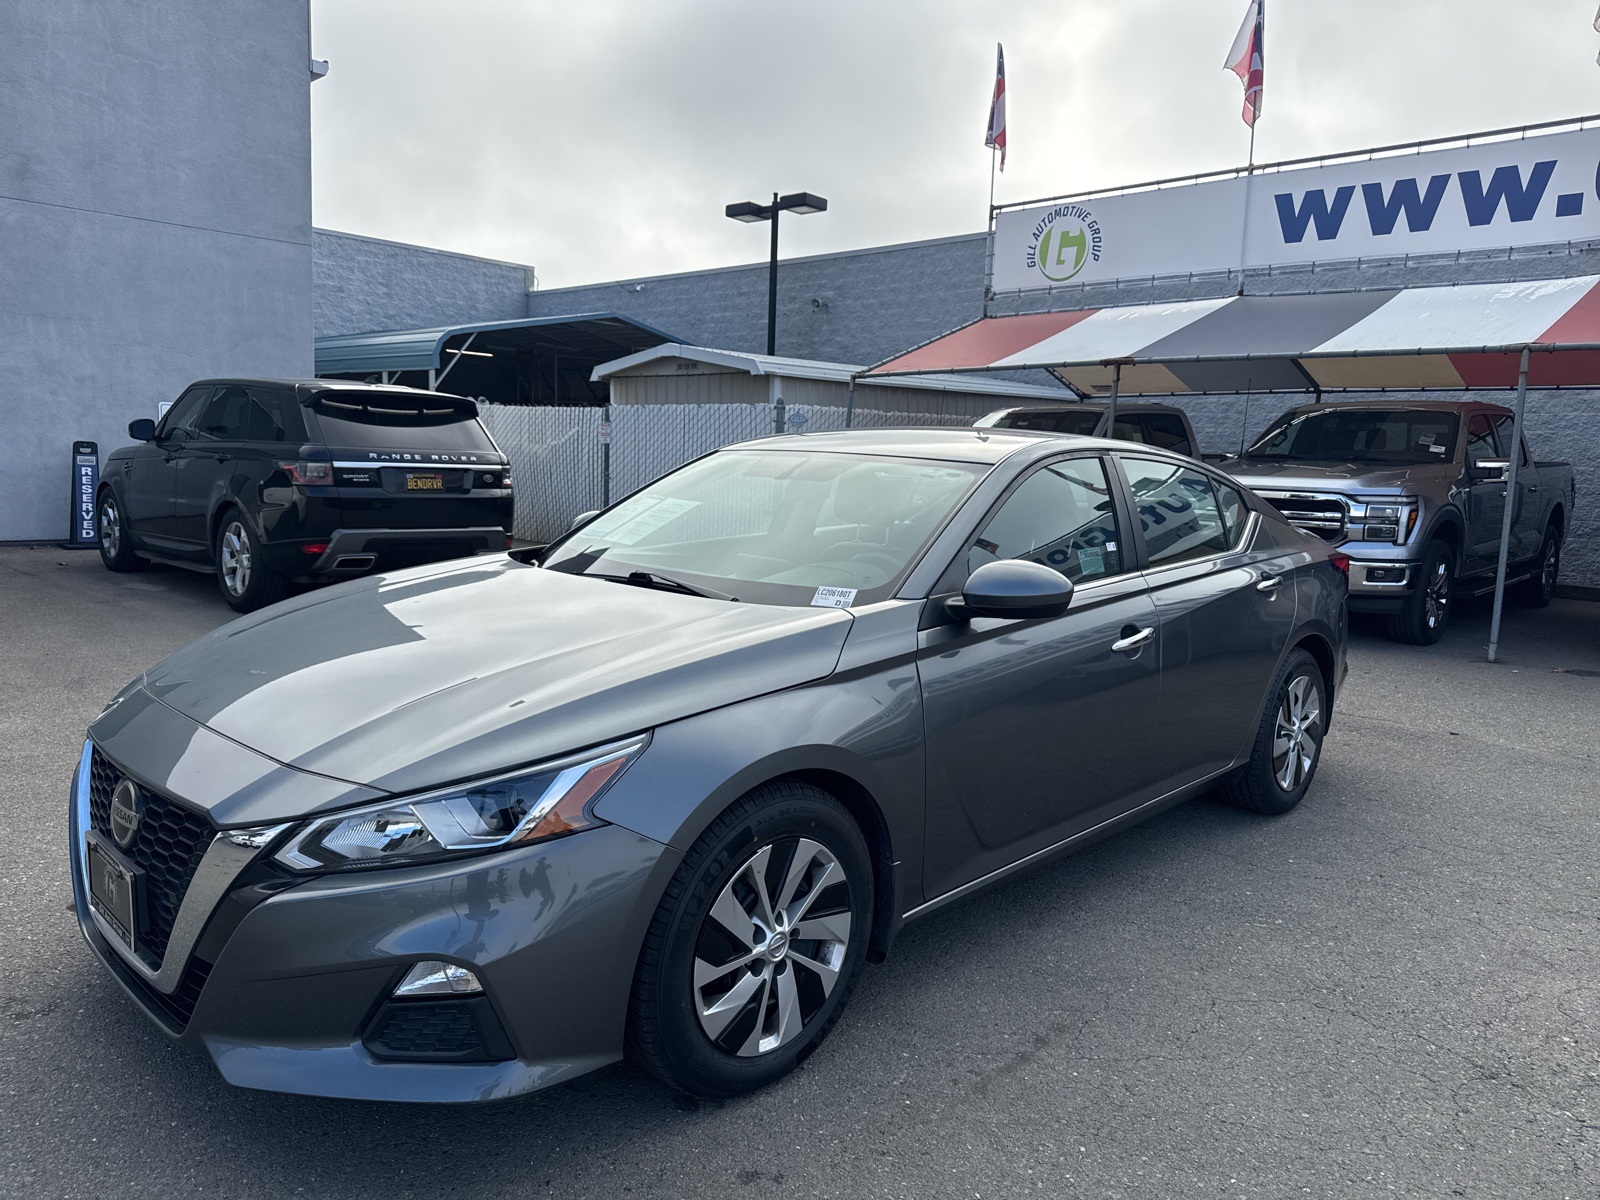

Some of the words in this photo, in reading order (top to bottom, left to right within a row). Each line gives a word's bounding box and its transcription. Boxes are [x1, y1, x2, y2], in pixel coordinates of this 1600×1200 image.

[1026, 244, 1037, 268] GILL
[1032, 205, 1092, 242] AUTOMOTIVE
[1087, 220, 1102, 262] GROUP
[369, 452, 422, 461] RANGE
[431, 454, 478, 462] ROVER
[407, 478, 443, 490] BENDRVR
[81, 467, 95, 538] RESERVED
[756, 813, 776, 827] ALL
[778, 806, 818, 817] SEASON
